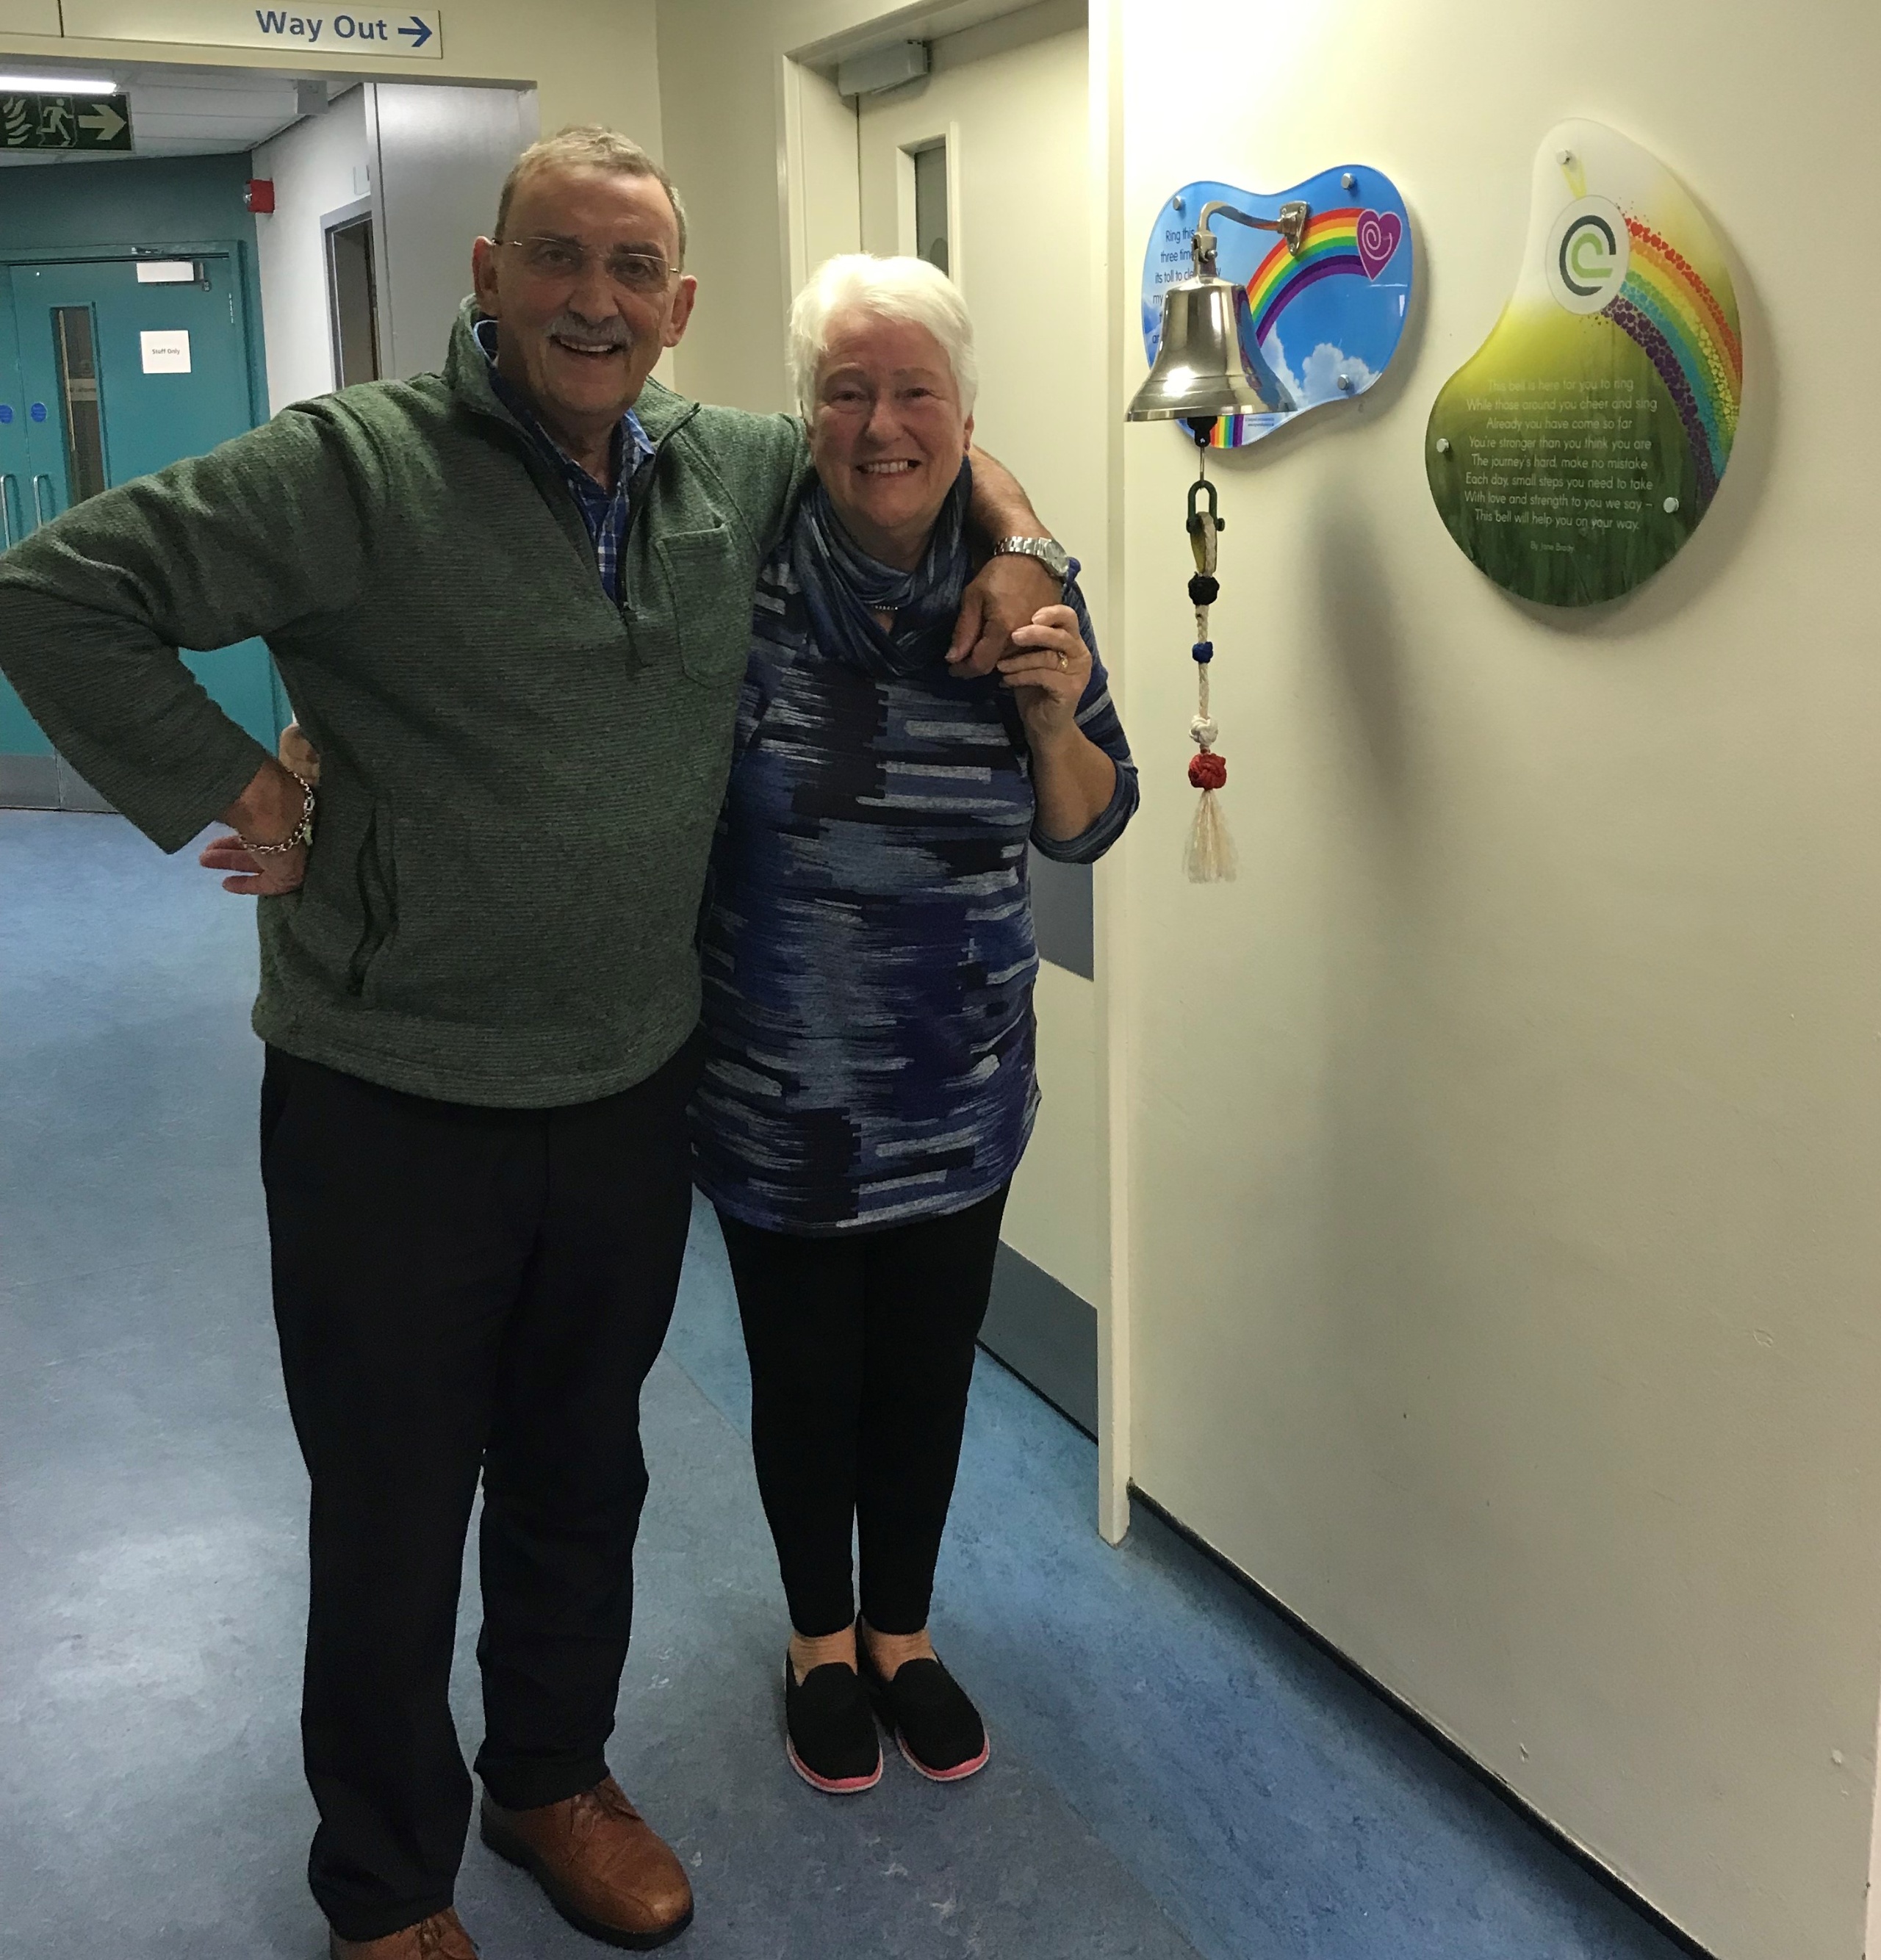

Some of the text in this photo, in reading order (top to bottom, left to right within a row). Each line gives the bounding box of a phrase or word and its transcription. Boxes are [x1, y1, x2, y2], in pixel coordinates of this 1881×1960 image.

[256, 10, 388, 43] Way Out
[1165, 226, 1195, 244] Ring this
[1161, 250, 1179, 263] three
[1155, 272, 1163, 284] its
[1165, 269, 1174, 283] toll
[1176, 270, 1183, 281] to
[1539, 378, 1560, 391] here
[1563, 378, 1576, 390] for
[1579, 381, 1597, 393] you
[1601, 378, 1611, 389] to
[1614, 378, 1634, 392] ring
[1466, 396, 1658, 414] While those around you cheer and sing
[1486, 416, 1633, 432] Already you have come so far
[1499, 438, 1536, 452] stronger
[1539, 435, 1561, 448] than
[1563, 439, 1581, 452] you
[1585, 435, 1608, 450] think
[1611, 439, 1630, 452] you
[1633, 440, 1652, 450] are
[1471, 453, 1489, 466] The
[1490, 455, 1531, 470] journey's
[1561, 455, 1589, 469] make
[1592, 459, 1605, 469] no
[1607, 456, 1648, 470] mistake
[1466, 471, 1489, 485] Each
[1511, 472, 1536, 486] small
[1539, 476, 1564, 491] steps
[1567, 478, 1584, 490] you
[1588, 475, 1614, 489] need
[1616, 477, 1627, 490] to
[1630, 476, 1653, 491] take
[1464, 490, 1485, 502] With
[1488, 490, 1506, 504] love
[1508, 491, 1528, 505] and
[1530, 493, 1569, 509] strength
[1571, 495, 1581, 507] to
[1583, 498, 1602, 511] you
[1605, 500, 1621, 509] we
[1624, 500, 1643, 513] say
[1475, 508, 1493, 522] This
[1495, 509, 1511, 522] bell
[1514, 511, 1529, 524] will
[1531, 511, 1553, 527] help
[1555, 516, 1572, 529] you
[1575, 517, 1588, 527] on
[1591, 518, 1614, 530] your
